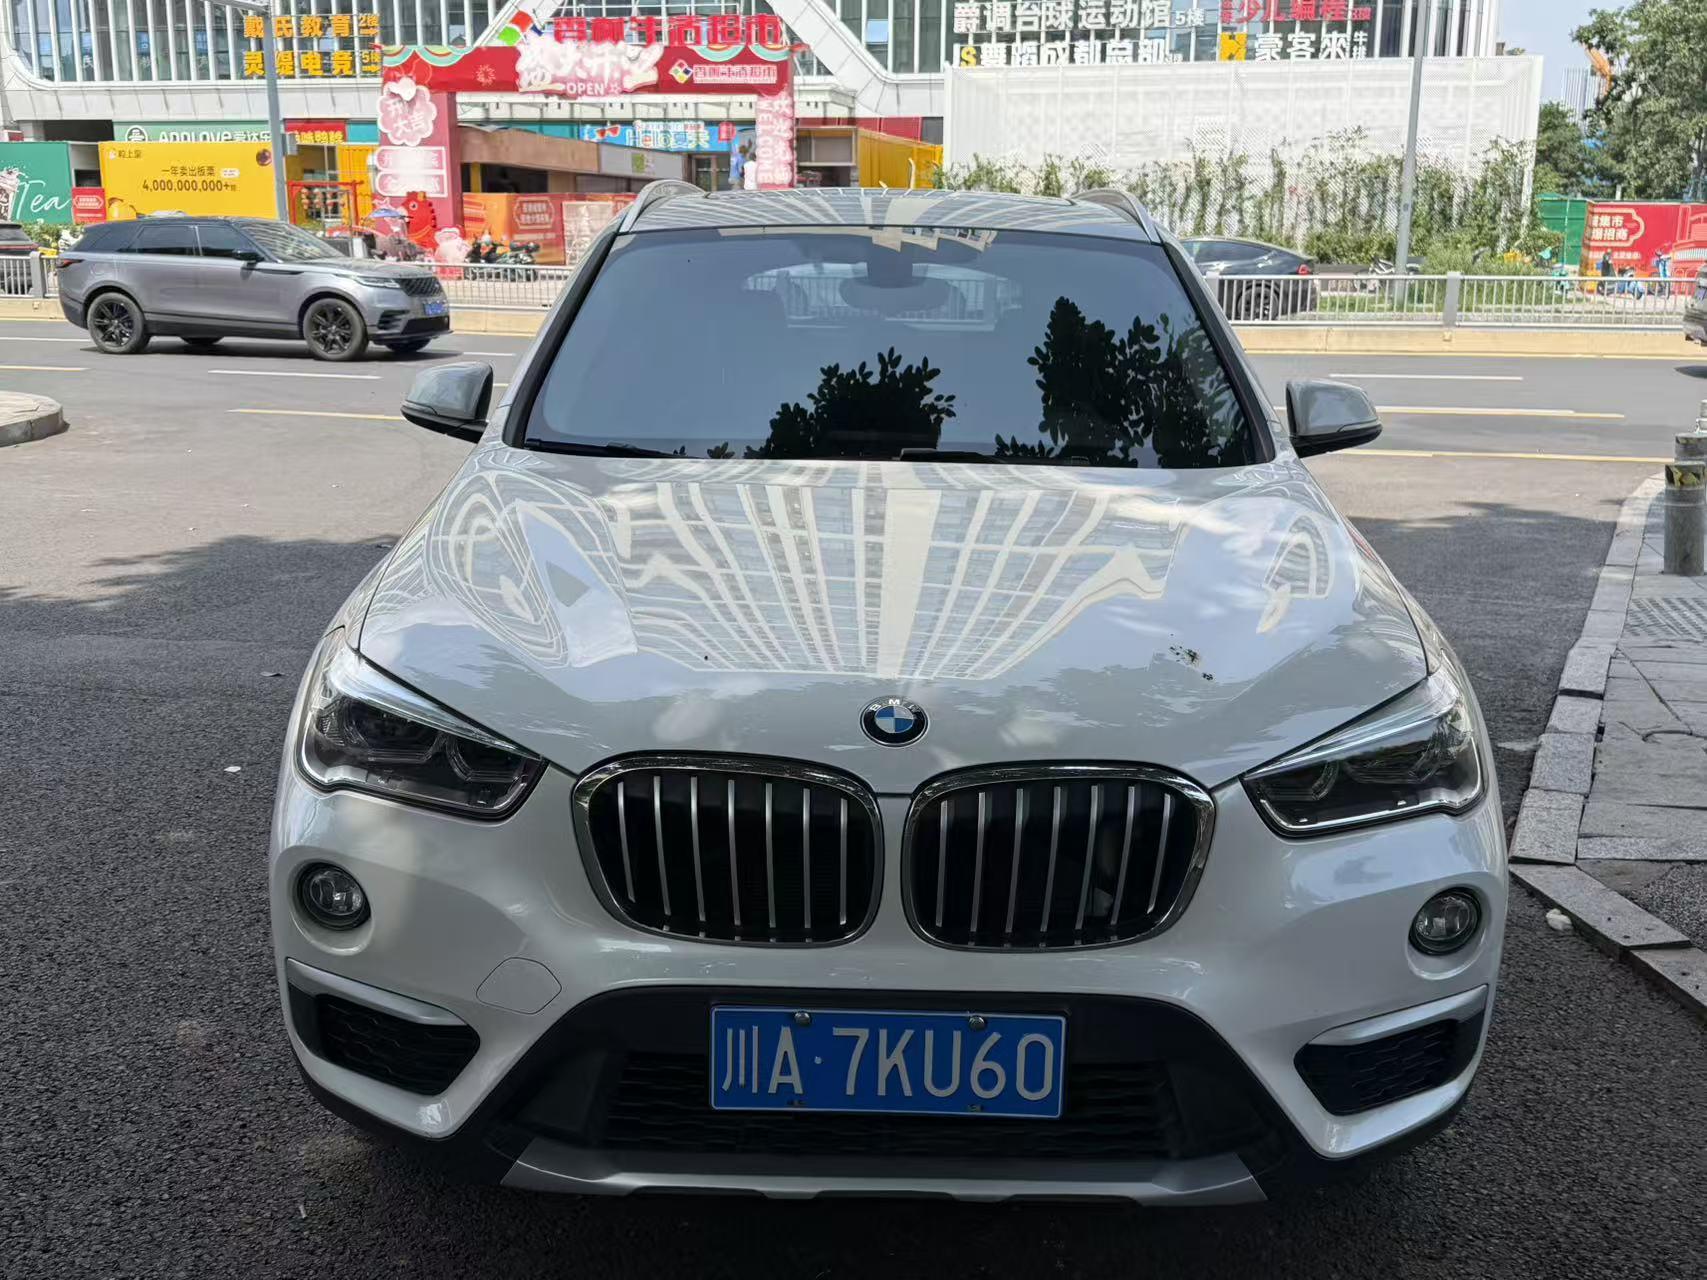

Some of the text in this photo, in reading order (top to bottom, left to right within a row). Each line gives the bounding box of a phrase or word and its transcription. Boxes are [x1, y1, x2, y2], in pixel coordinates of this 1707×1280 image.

[1175, 9, 1206, 26] 5楼
[244, 15, 351, 38] 戴氏教育
[566, 82, 605, 96] OPEN
[161, 166, 216, 177] 一年卖出板栗
[142, 179, 230, 192] 4,000,000,000+
[16, 180, 73, 220] Tea
[721, 1025, 1055, 1101] 川A·7KU60
